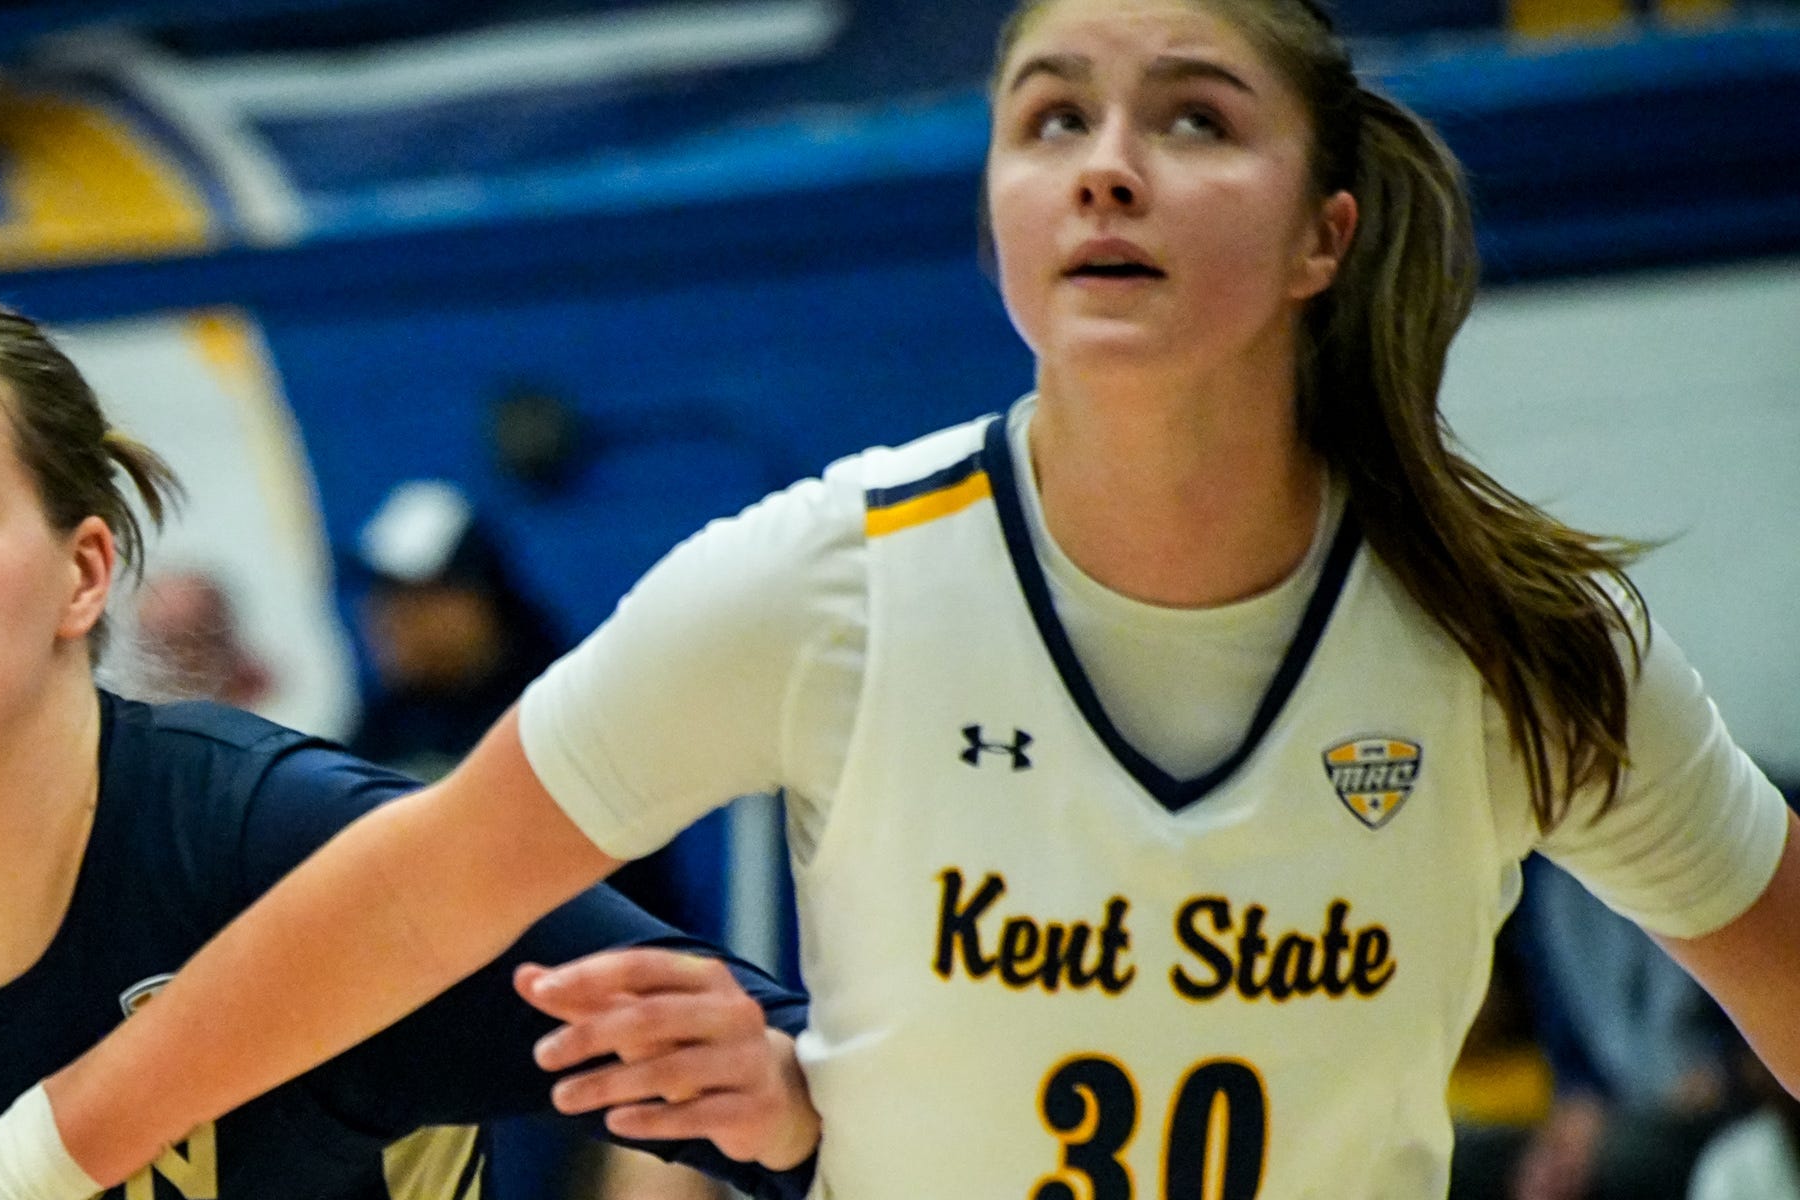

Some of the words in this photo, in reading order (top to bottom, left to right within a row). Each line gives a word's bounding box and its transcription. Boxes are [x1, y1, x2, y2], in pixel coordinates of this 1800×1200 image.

[1331, 762, 1417, 794] MAC
[933, 866, 1137, 997] Kent
[1169, 894, 1398, 1004] State
